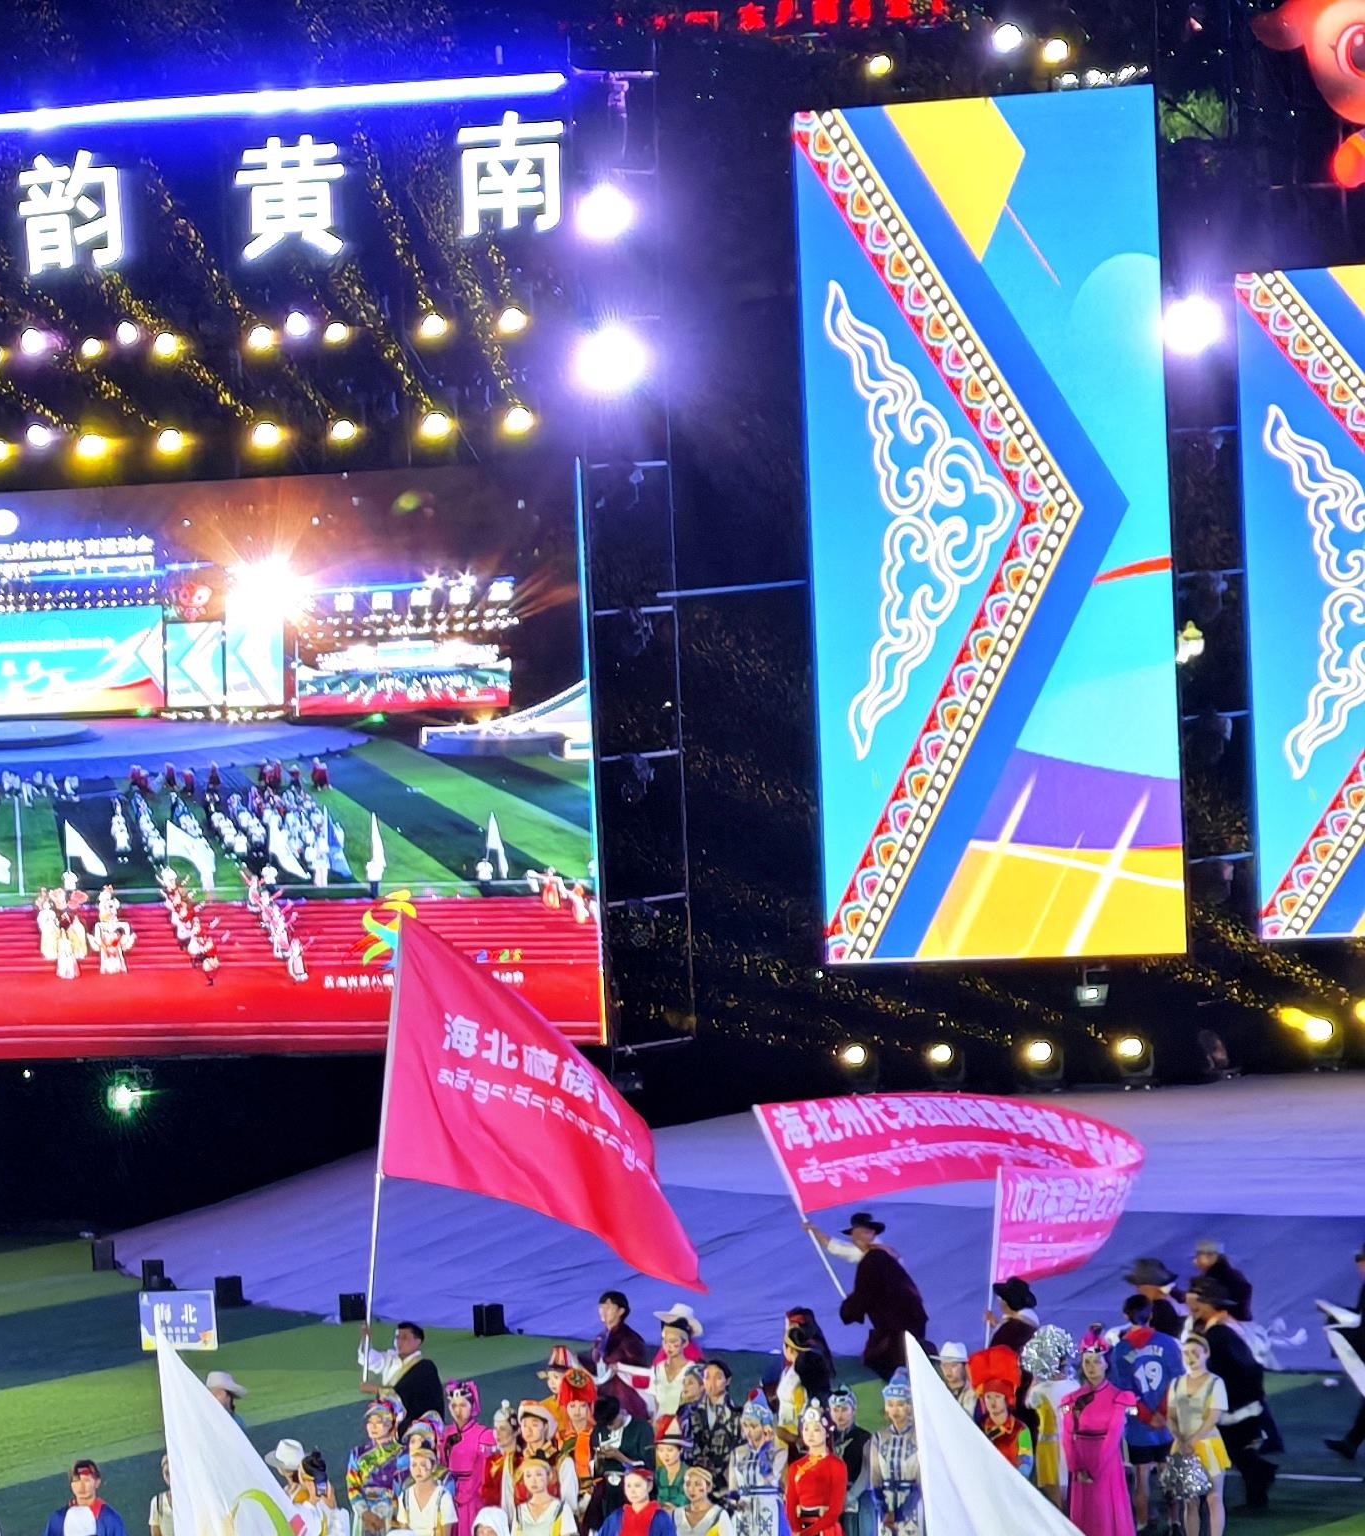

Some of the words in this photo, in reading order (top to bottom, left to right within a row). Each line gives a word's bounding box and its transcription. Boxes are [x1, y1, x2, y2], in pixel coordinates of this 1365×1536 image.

[442, 1012, 621, 1128] 海北藏族
[1134, 1361, 1163, 1394] 19
